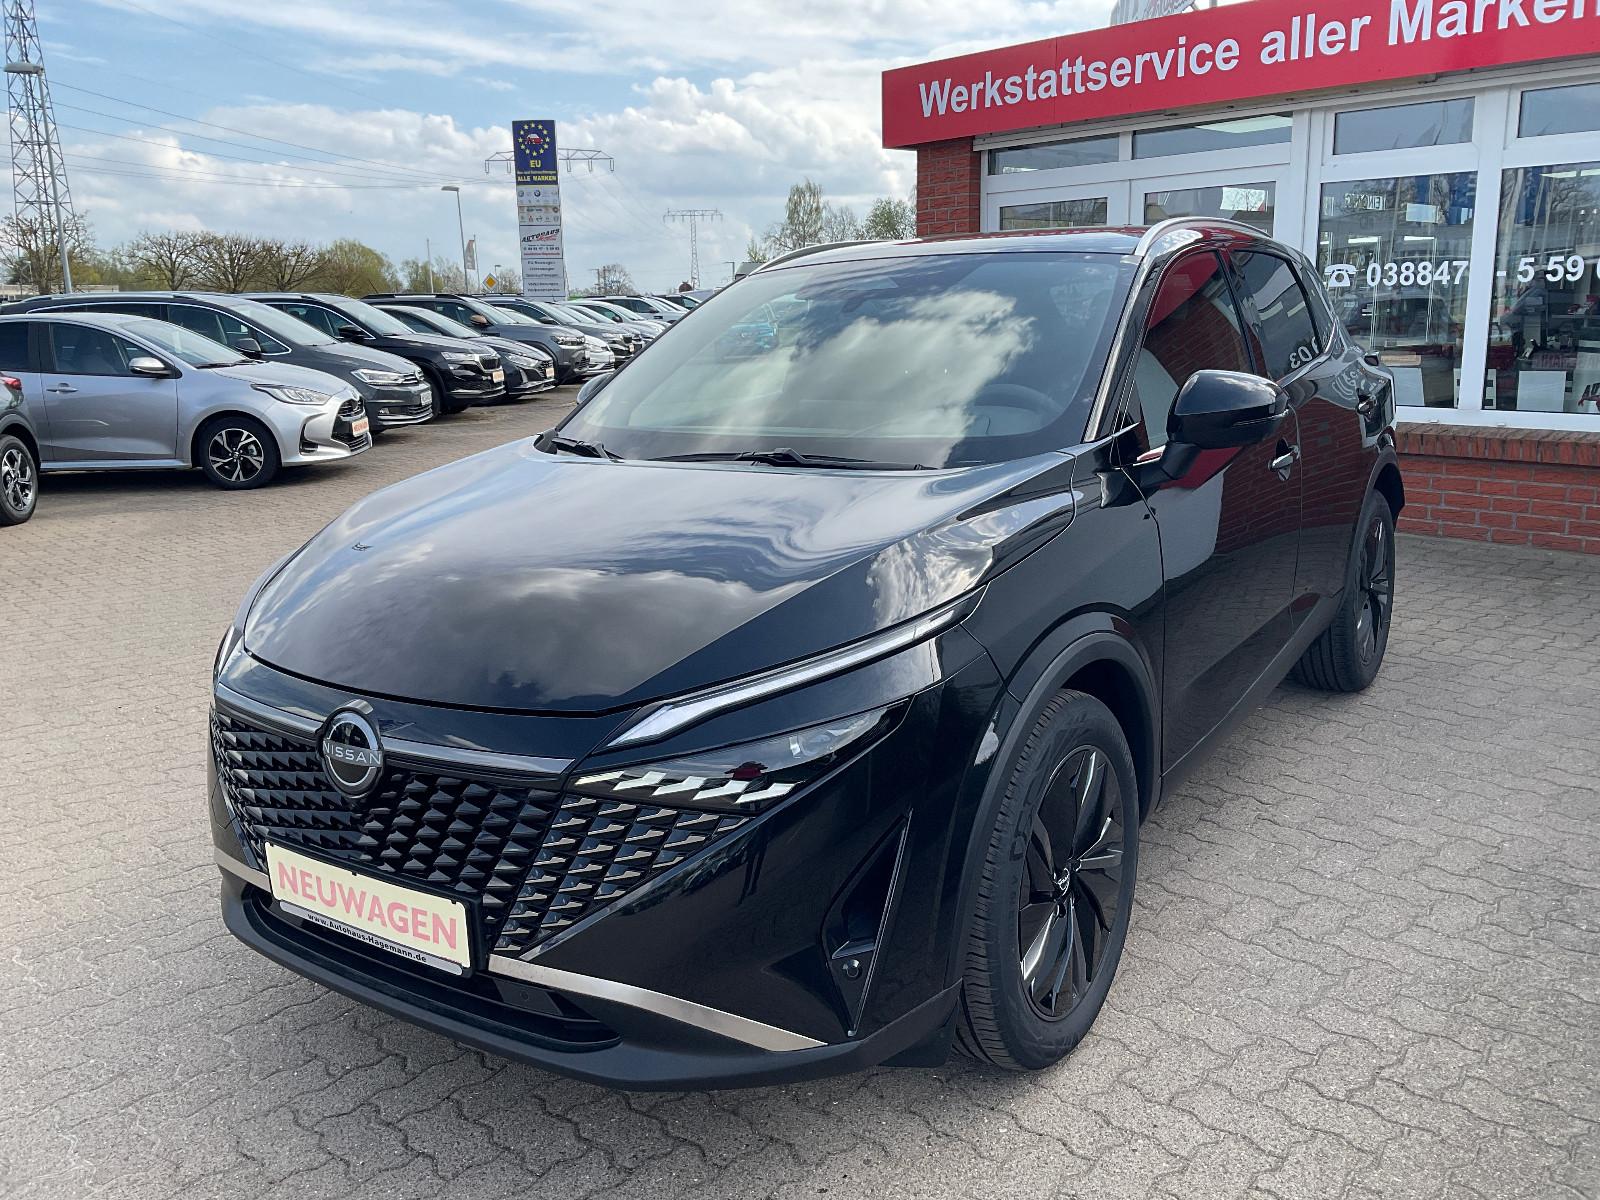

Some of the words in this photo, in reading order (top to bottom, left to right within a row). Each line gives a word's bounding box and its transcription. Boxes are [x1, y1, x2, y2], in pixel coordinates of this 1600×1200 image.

[919, 36, 1240, 118] Werkstattservice
[1260, 13, 1372, 65] aller
[530, 159, 541, 168] EU
[1366, 260, 1469, 287] 038847
[1517, 257, 1535, 283] 5
[1546, 255, 1585, 282] 59
[322, 740, 381, 765] NISSAN
[278, 861, 457, 950] NEUWAGEN
[307, 913, 427, 962] www.Autohaus-Hagemann.de
